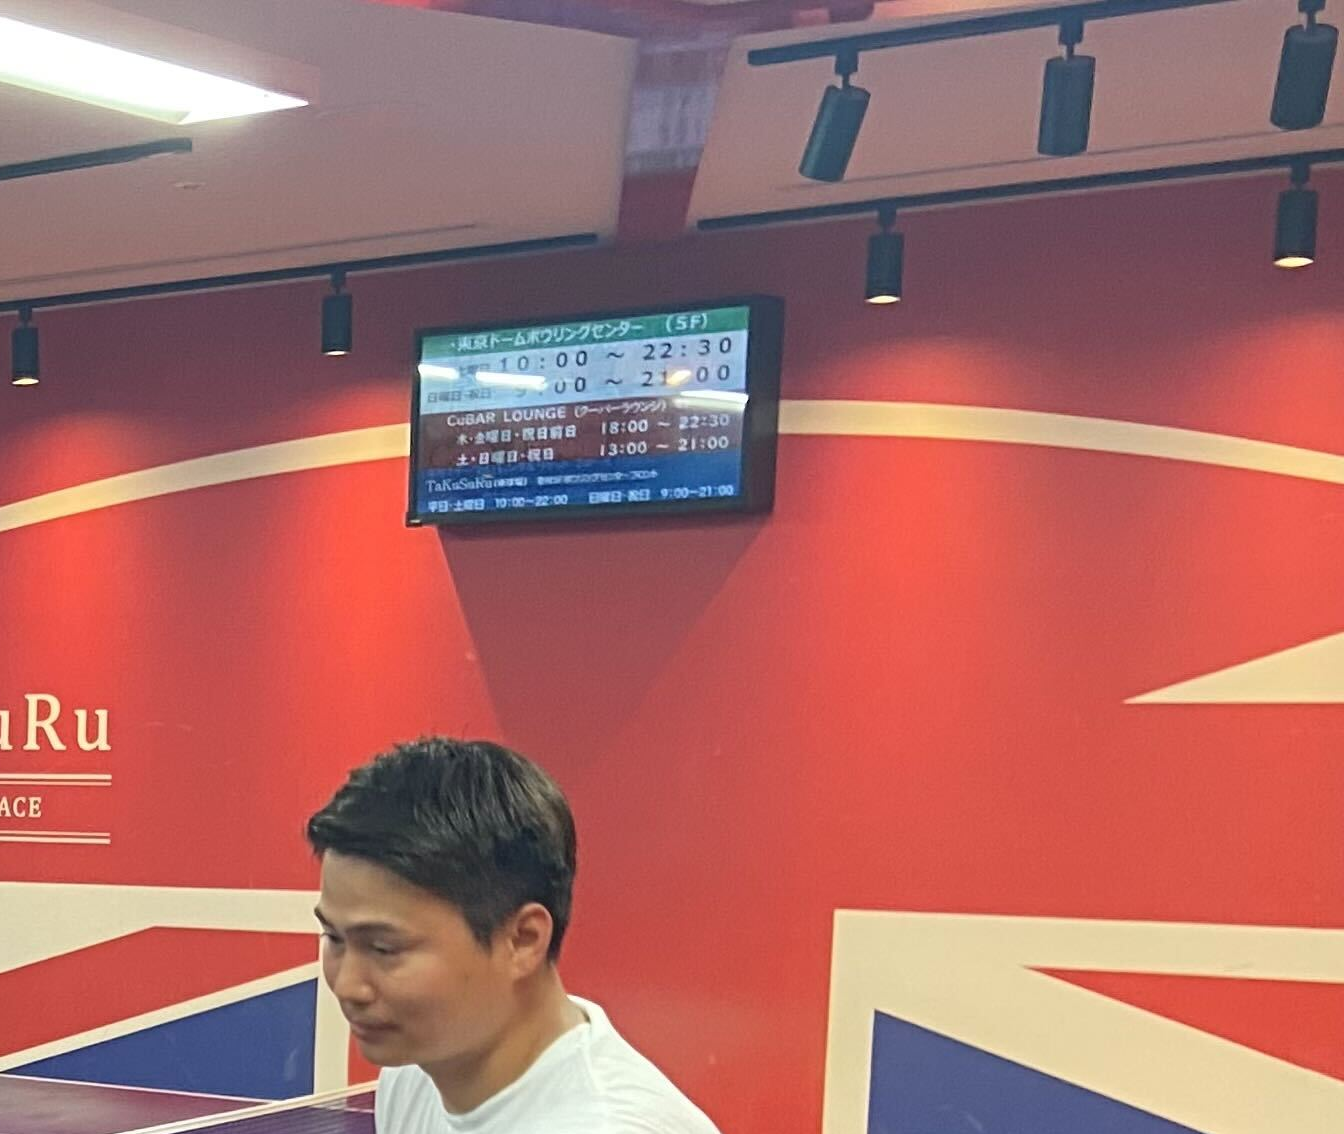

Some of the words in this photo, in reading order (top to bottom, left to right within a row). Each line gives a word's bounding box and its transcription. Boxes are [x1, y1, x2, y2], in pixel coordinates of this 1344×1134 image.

[642, 337, 731, 361] 22:30
[503, 406, 566, 422] LOUNGE
[601, 419, 648, 435] 18:00
[600, 441, 647, 457] 13:00
[677, 436, 729, 451] 21:00
